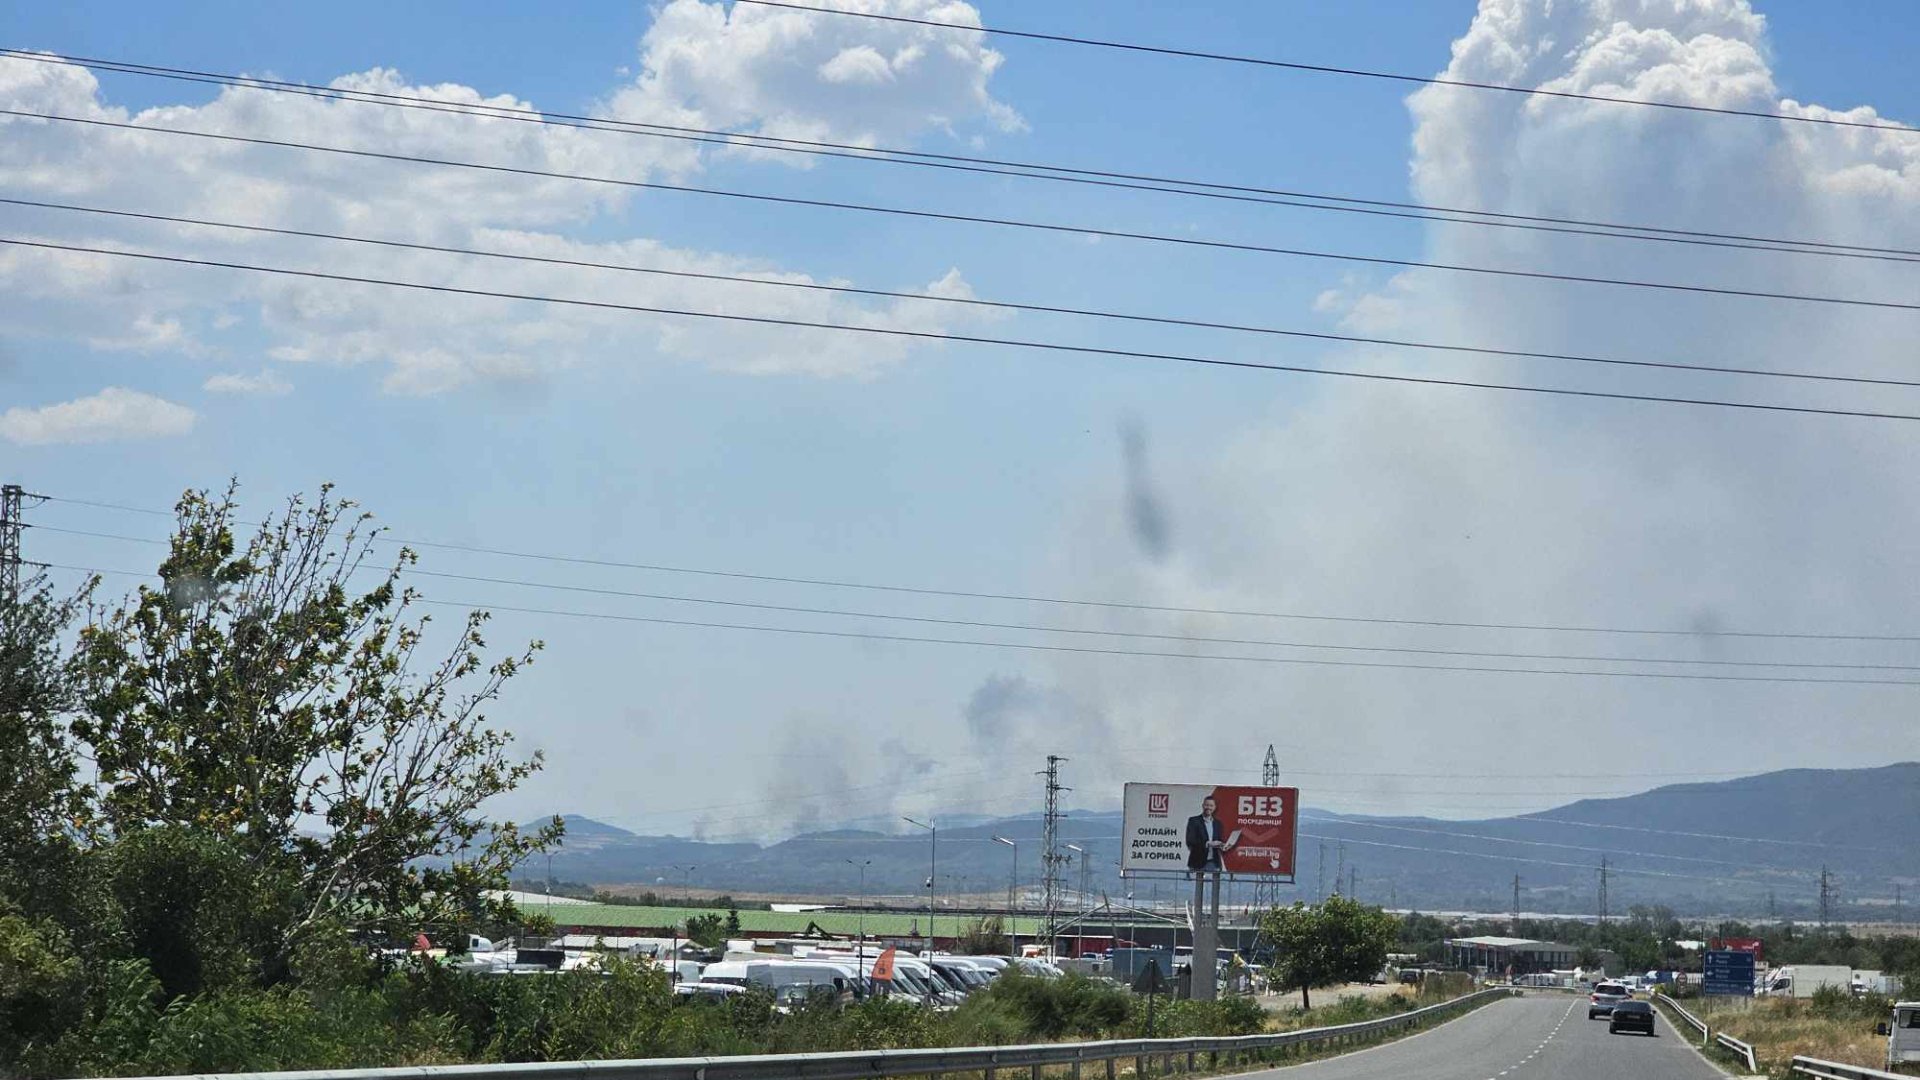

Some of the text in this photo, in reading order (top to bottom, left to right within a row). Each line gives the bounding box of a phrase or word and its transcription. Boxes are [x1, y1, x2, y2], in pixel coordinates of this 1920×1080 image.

[1238, 796, 1283, 816] БЕЗ
[1138, 827, 1177, 835] ОНЛАЙН
[1132, 839, 1182, 848] ДОГОВОРИ
[1131, 851, 1181, 860] ЗА ГОРИВА
